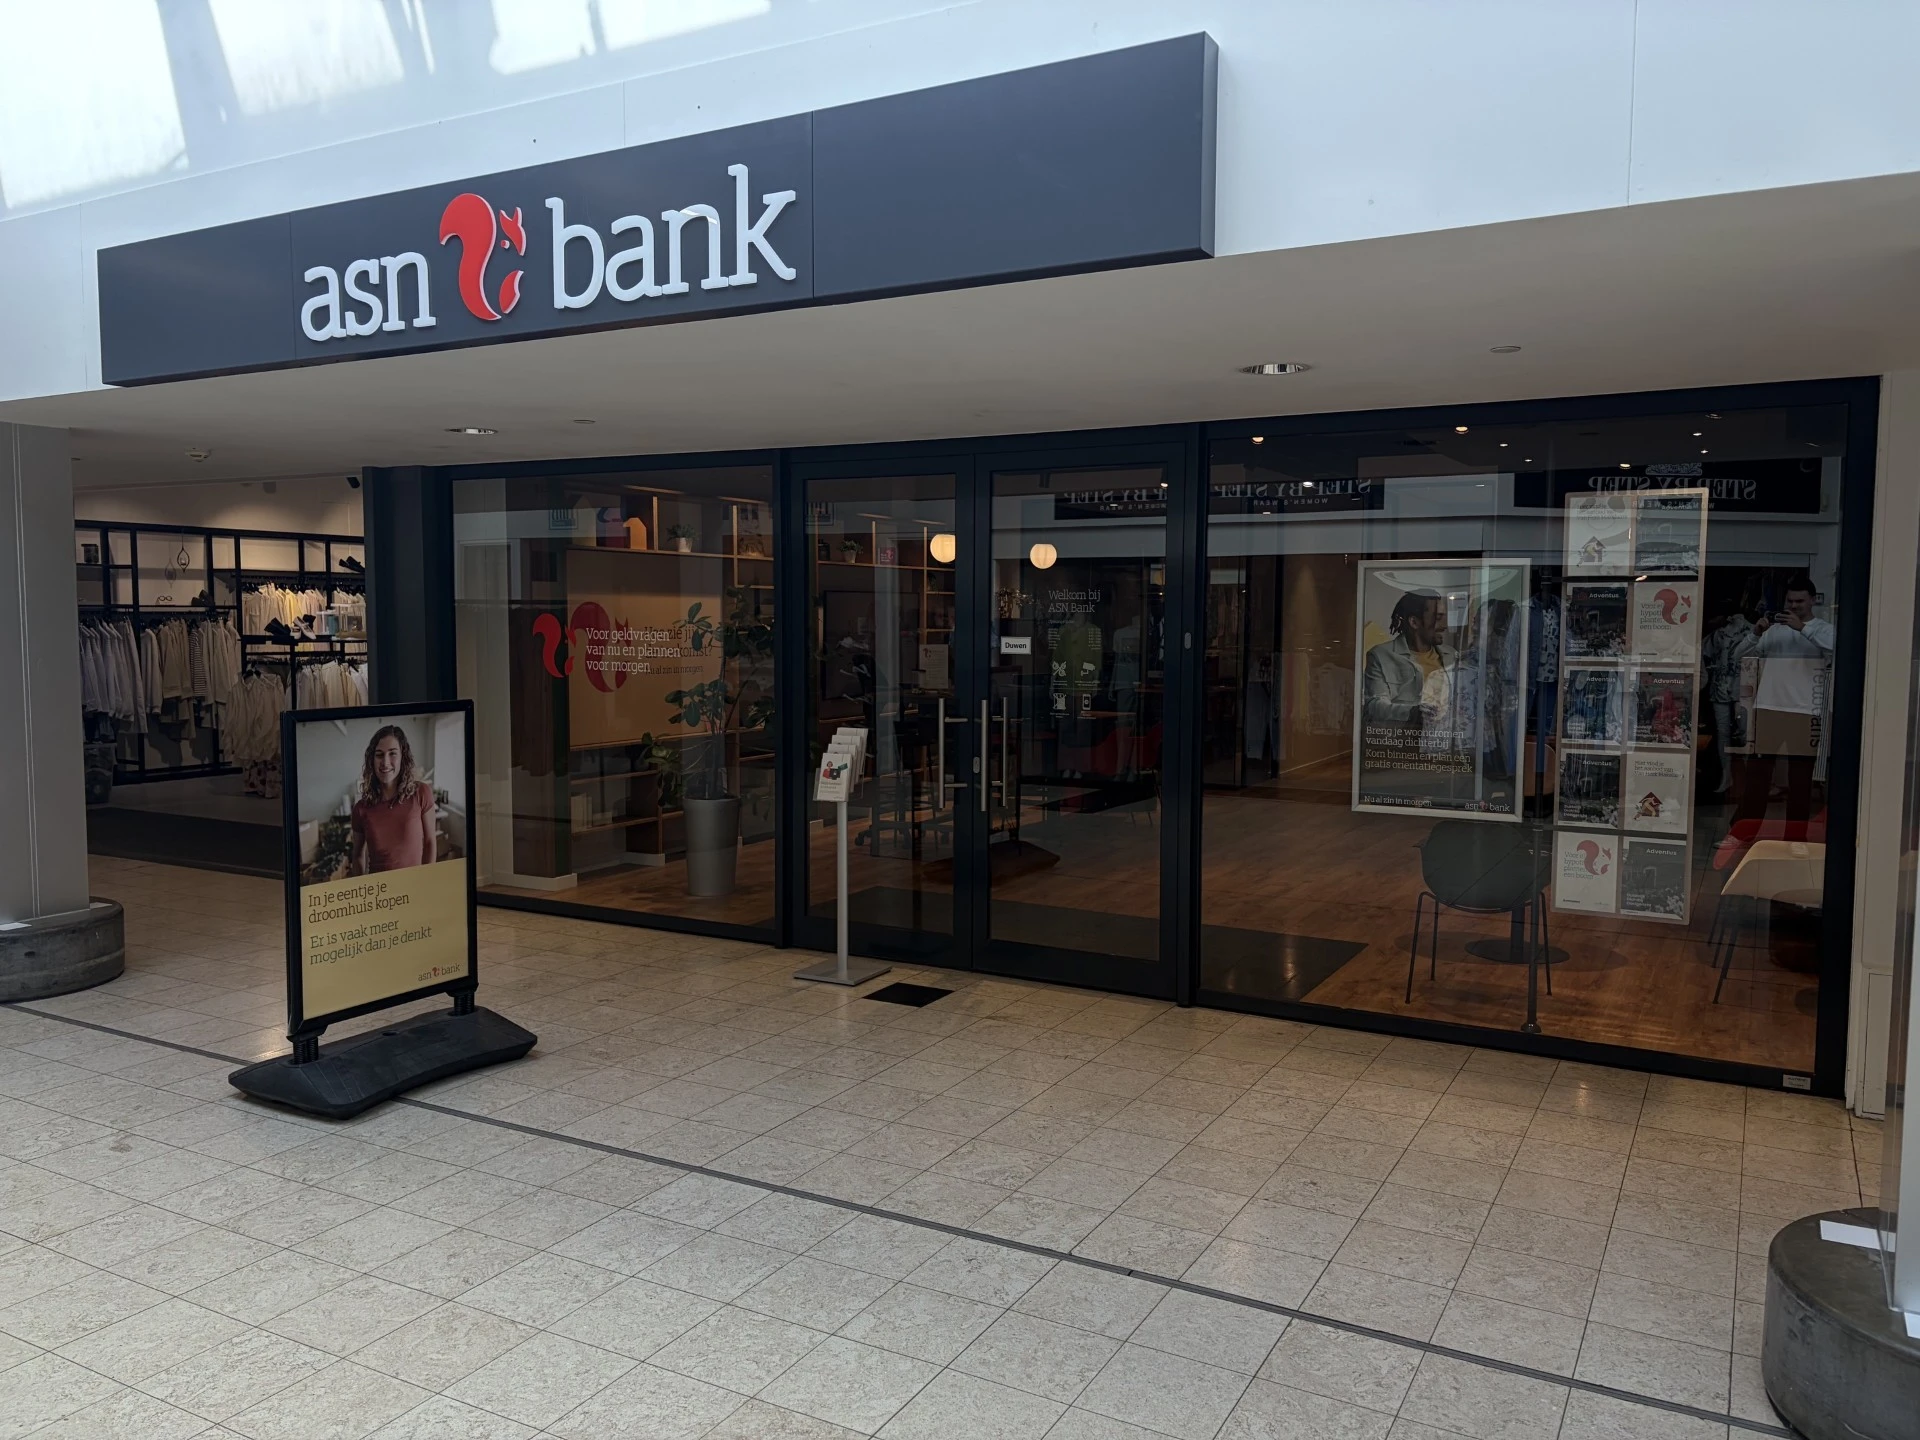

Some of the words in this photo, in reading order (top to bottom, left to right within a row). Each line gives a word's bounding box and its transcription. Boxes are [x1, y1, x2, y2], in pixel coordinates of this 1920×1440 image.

[300, 251, 437, 341] asn
[544, 163, 797, 309] bank
[1048, 589, 1085, 601] Welkom
[1088, 589, 1101, 603] bij
[1048, 602, 1069, 613] ASN
[1071, 602, 1096, 613] Bank
[586, 627, 610, 641] Voor
[611, 627, 671, 644] geldvragen
[586, 645, 605, 656] van
[607, 645, 621, 656] nu
[622, 645, 636, 657] en
[638, 644, 681, 660] plannen
[586, 660, 609, 671] voor
[611, 660, 650, 675] morgen
[1366, 726, 1393, 738] Breng
[1393, 727, 1403, 738] je
[1404, 728, 1464, 739] woondromen
[1365, 736, 1403, 748] vandaag
[1405, 737, 1450, 750] dichterbij
[1364, 759, 1391, 769] gratis
[1365, 749, 1386, 758] Kom
[1387, 749, 1418, 761] binnen
[1420, 753, 1431, 761] en
[1432, 751, 1451, 764] plan
[1454, 754, 1471, 764] een
[1364, 795, 1375, 804] Nu
[1383, 796, 1394, 804] zin
[1394, 797, 1403, 805] in
[1403, 799, 1433, 808] morgen
[1464, 802, 1479, 810] asn
[1490, 802, 1510, 812] bank
[1645, 847, 1677, 856] Adventus
[308, 893, 322, 908] In
[322, 891, 335, 908] je
[336, 884, 374, 902] eentje
[375, 881, 388, 897] je
[308, 900, 373, 924] droomhuis
[375, 894, 410, 911] kopen
[310, 935, 324, 949] Er
[326, 932, 338, 946] is
[339, 924, 368, 942] vaak
[370, 920, 400, 936] meer
[310, 941, 363, 966] mogelijk
[365, 937, 387, 952] dan
[388, 935, 399, 949] je
[400, 926, 432, 944] denkt
[418, 971, 432, 982] asn
[441, 963, 461, 976] bank
